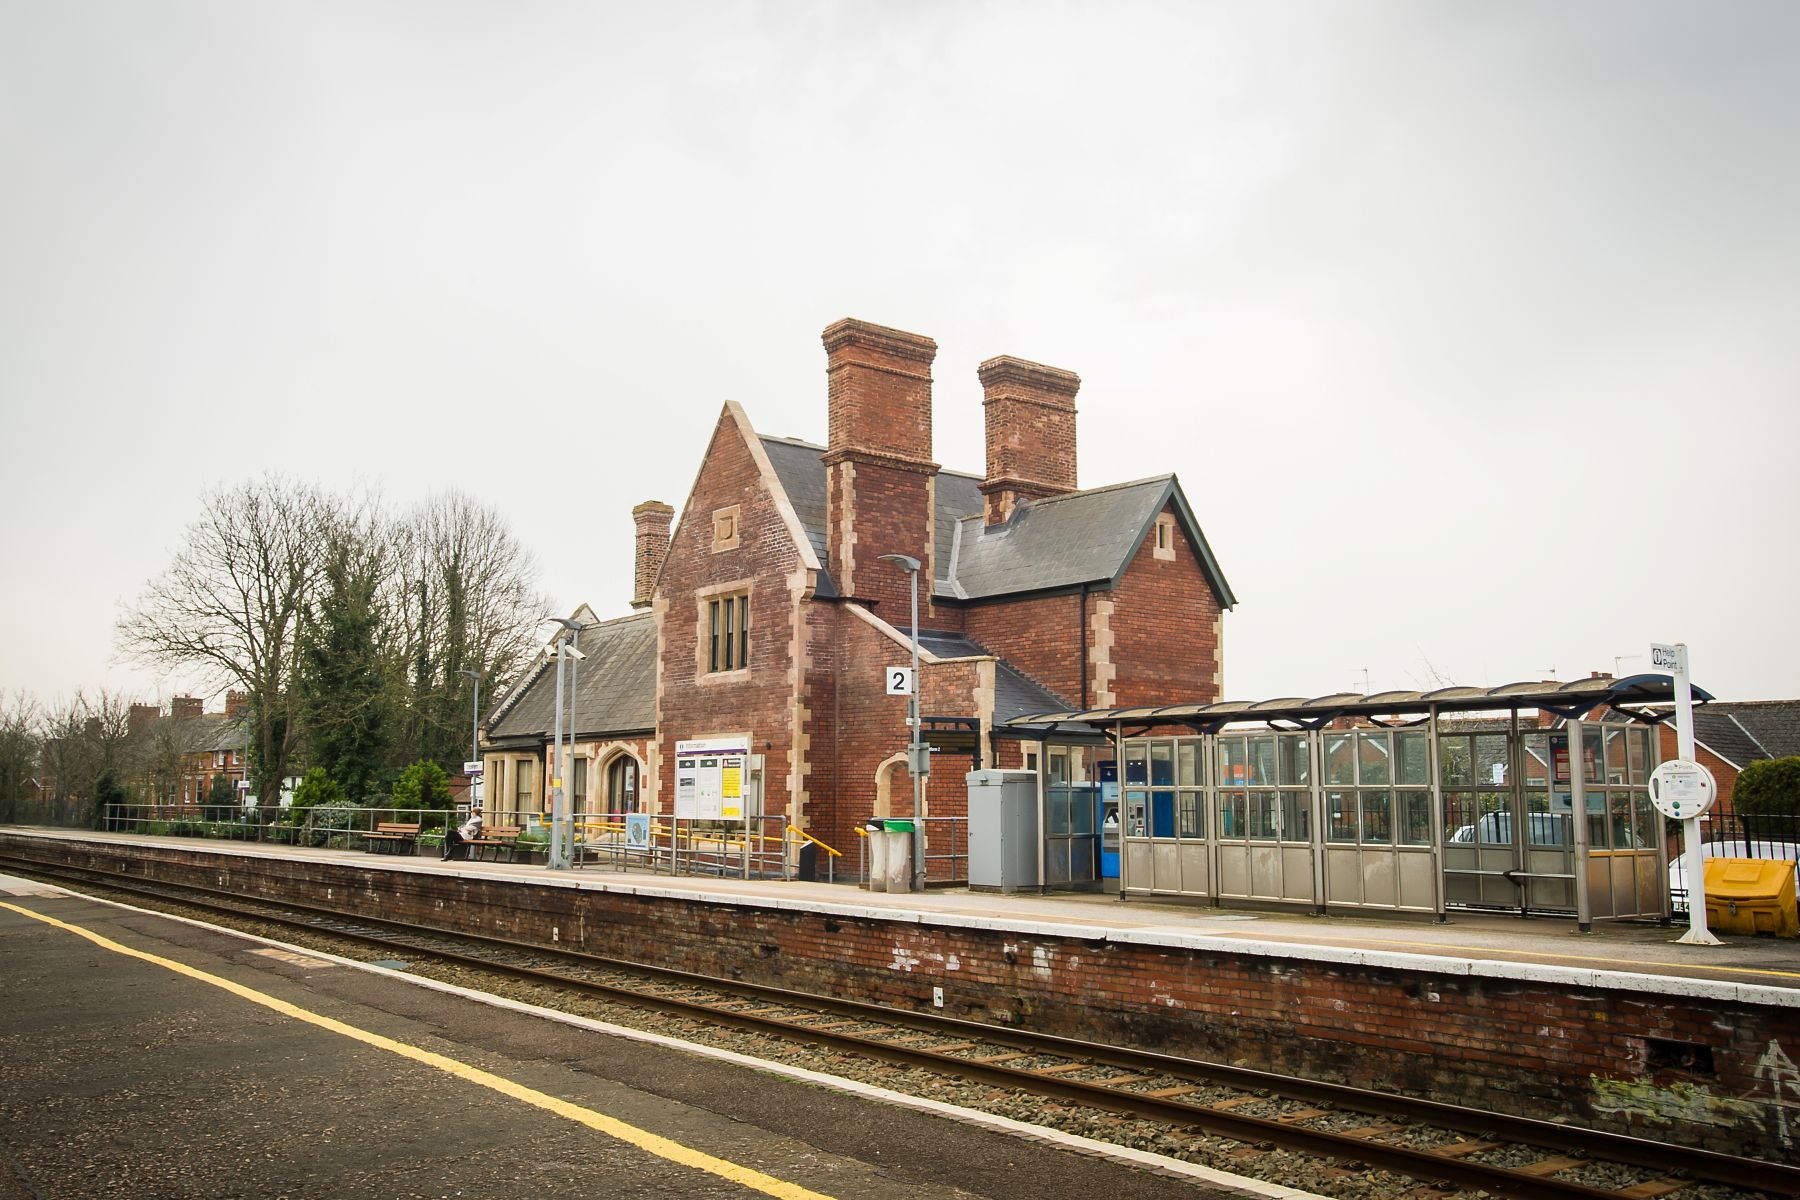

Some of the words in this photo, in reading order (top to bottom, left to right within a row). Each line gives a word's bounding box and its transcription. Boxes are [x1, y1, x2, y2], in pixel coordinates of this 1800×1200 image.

[1662, 647, 1675, 658] Help
[1663, 659, 1677, 669] Point
[892, 672, 905, 690] 2
